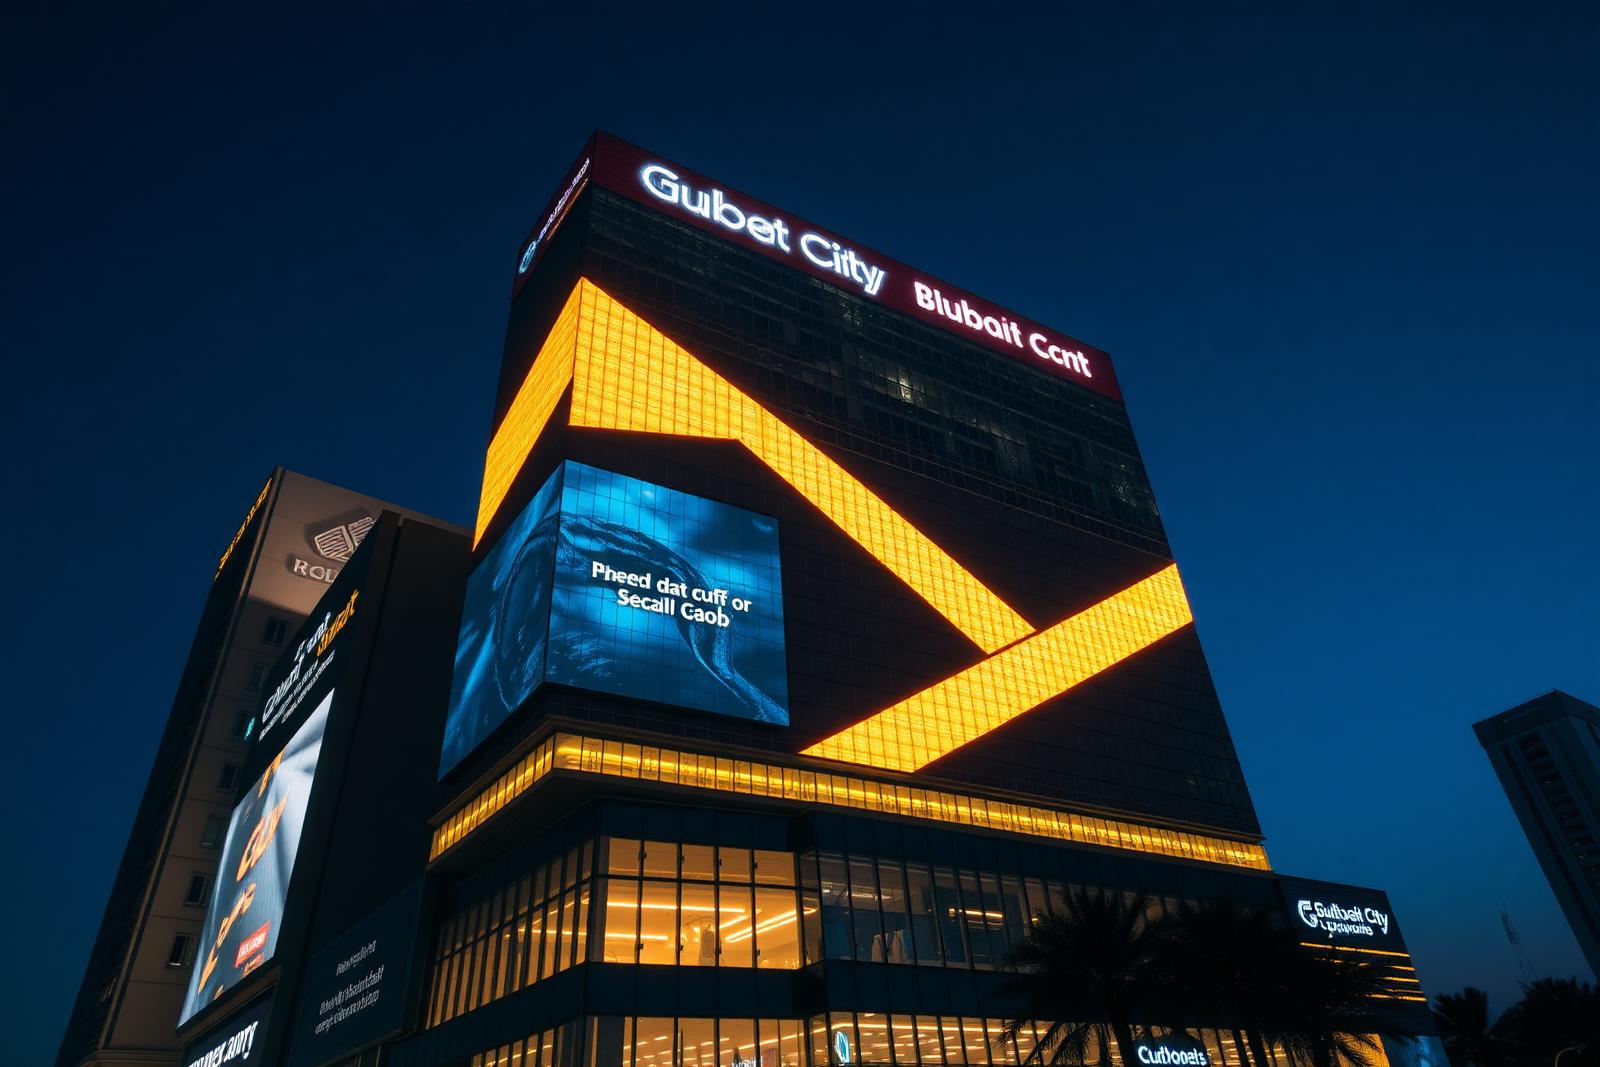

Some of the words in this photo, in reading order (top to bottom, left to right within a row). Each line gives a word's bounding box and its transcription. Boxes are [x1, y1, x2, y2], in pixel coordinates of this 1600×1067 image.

[913, 280, 1024, 349] Blubait
[591, 560, 651, 590] Pheed
[656, 576, 688, 599] dat
[691, 588, 728, 608] cuff
[731, 598, 753, 613] or
[617, 588, 675, 616] Secall
